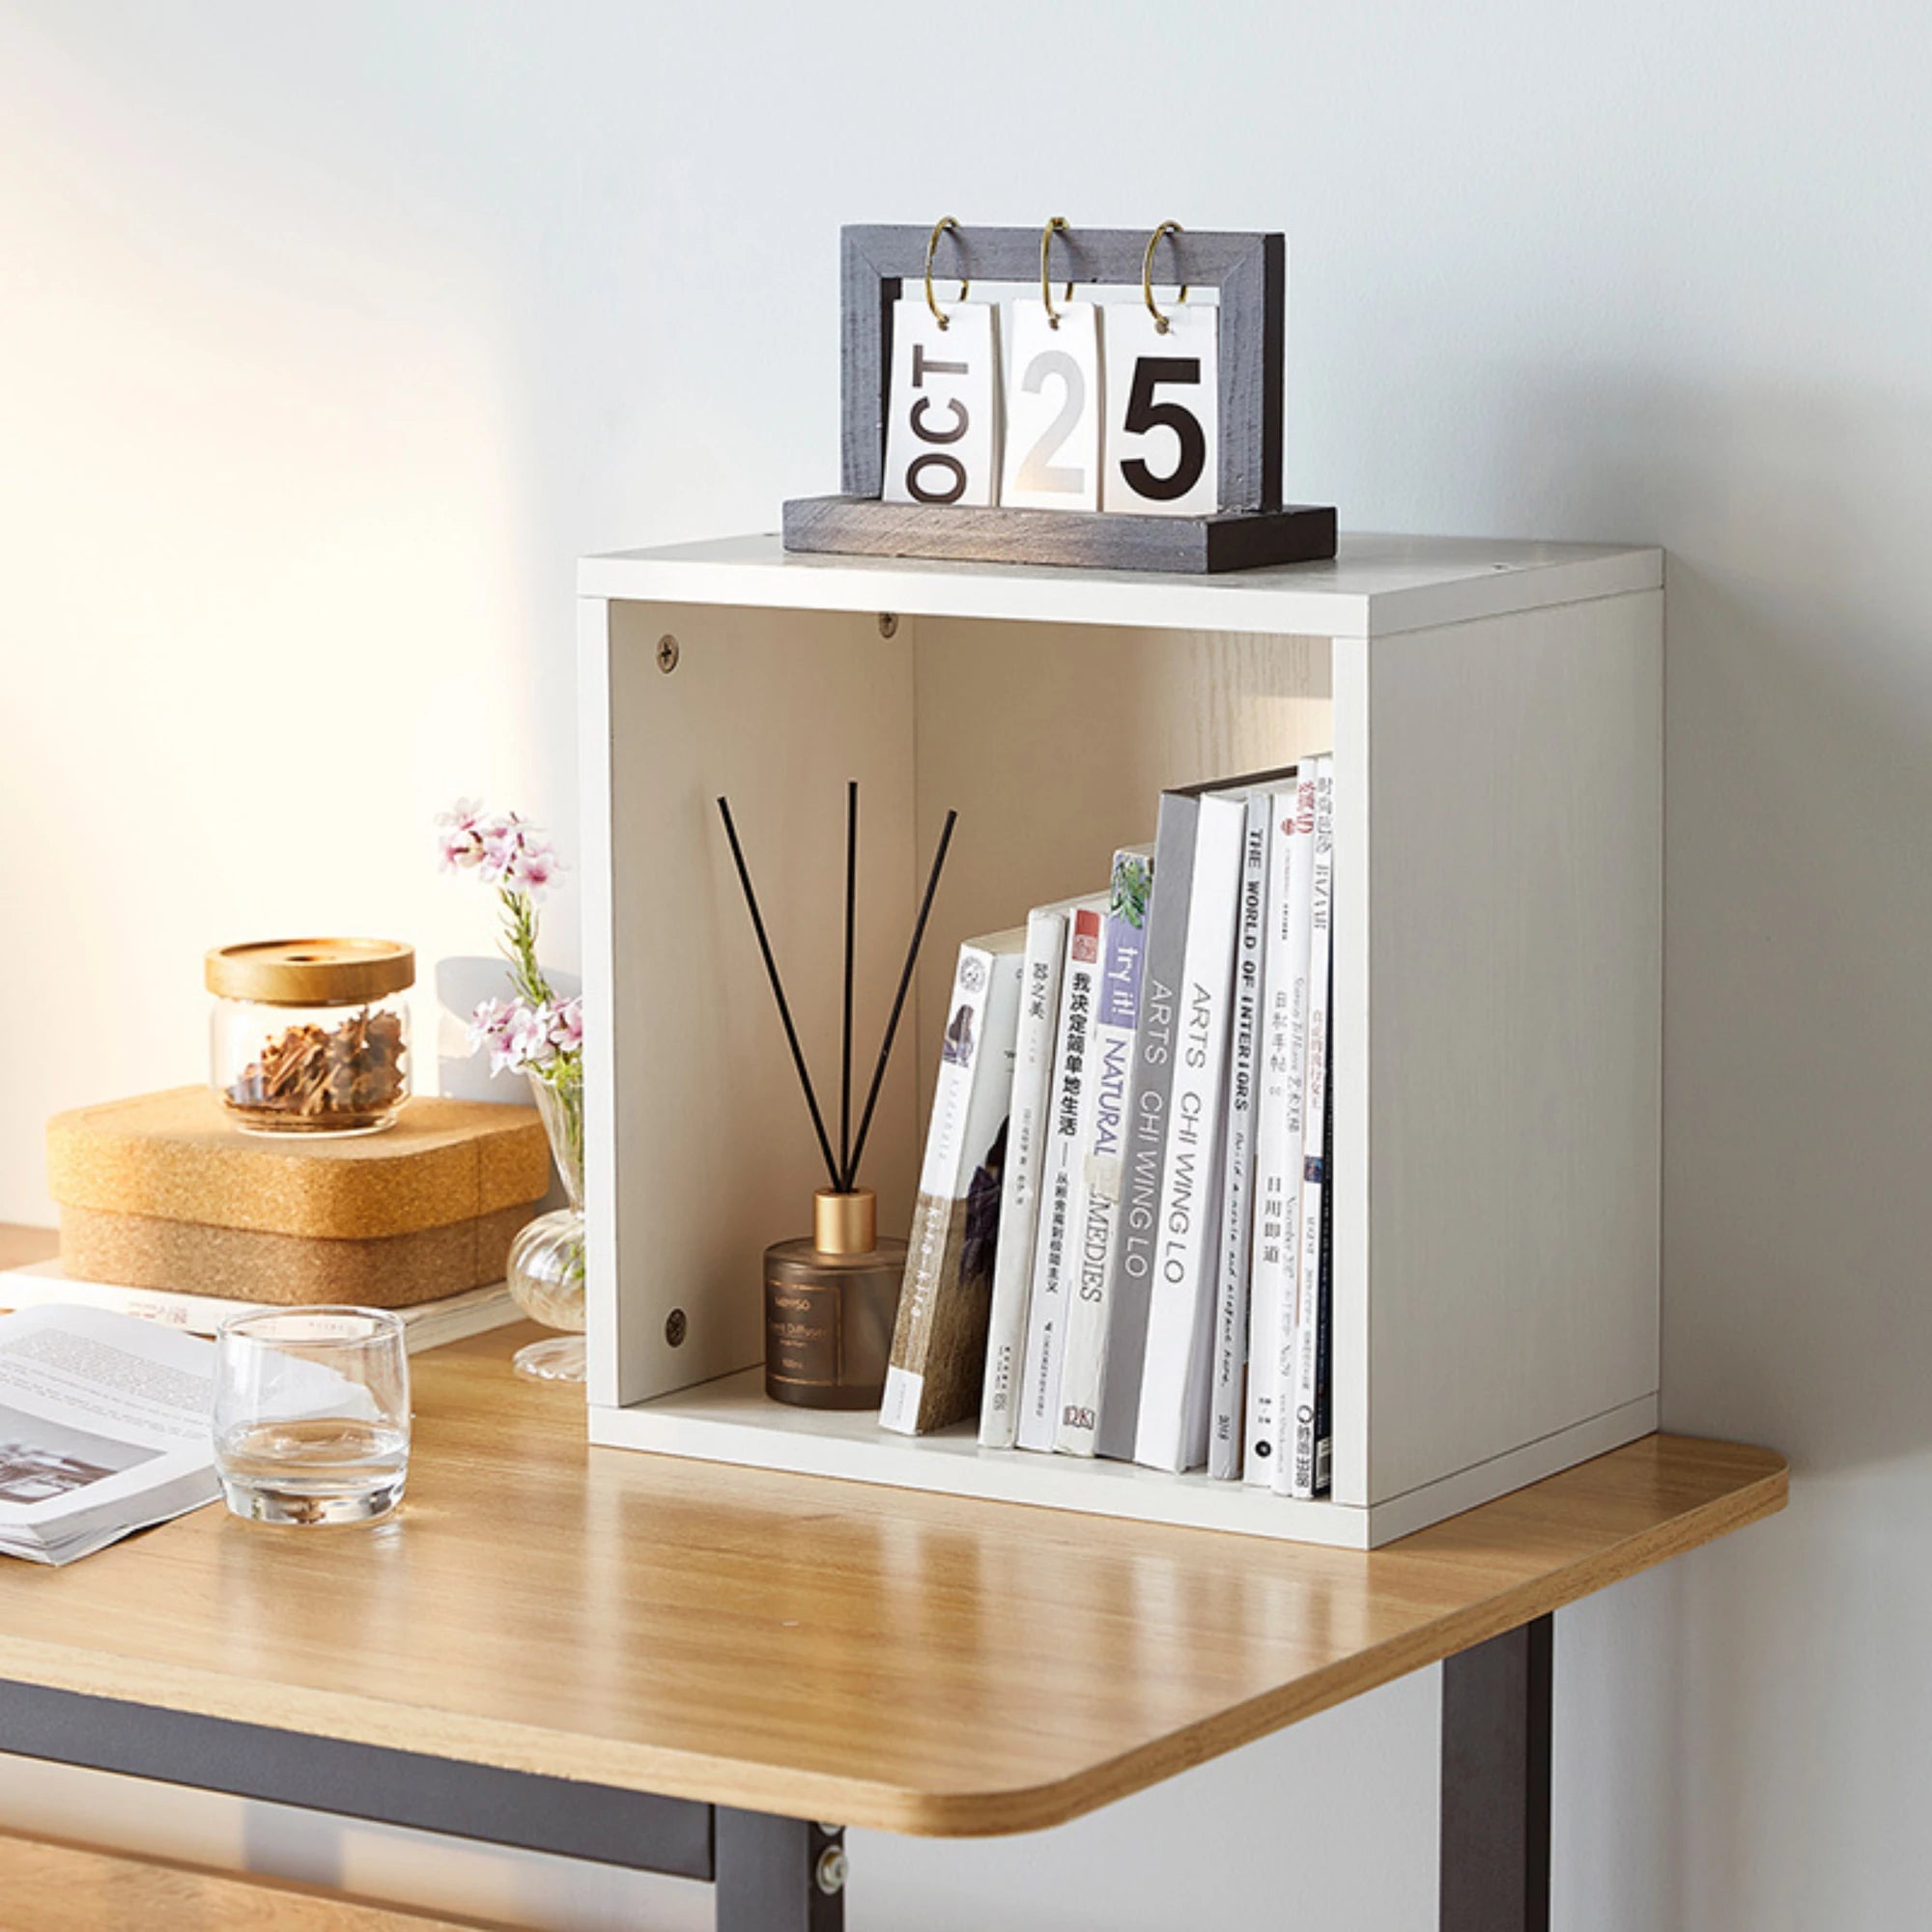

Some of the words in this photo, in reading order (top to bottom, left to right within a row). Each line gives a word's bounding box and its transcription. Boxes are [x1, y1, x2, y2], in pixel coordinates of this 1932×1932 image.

[905, 344, 969, 504] OCT
[1249, 829, 1264, 869] THE
[1244, 880, 1261, 950] WORLD
[1108, 946, 1139, 984] try
[1241, 960, 1256, 988] OF
[1110, 990, 1137, 1019] it!
[1144, 980, 1173, 1065] ARTS
[1185, 982, 1211, 1068] ARTS
[1235, 997, 1253, 1112] INTERIORS
[1094, 1037, 1128, 1157] NATURAL
[1136, 1091, 1162, 1145] CHI
[1179, 1091, 1203, 1145] CHI
[1129, 1149, 1159, 1233] WING
[1169, 1149, 1197, 1237] WING
[1124, 1236, 1151, 1278] LO
[1165, 1241, 1186, 1284] LO
